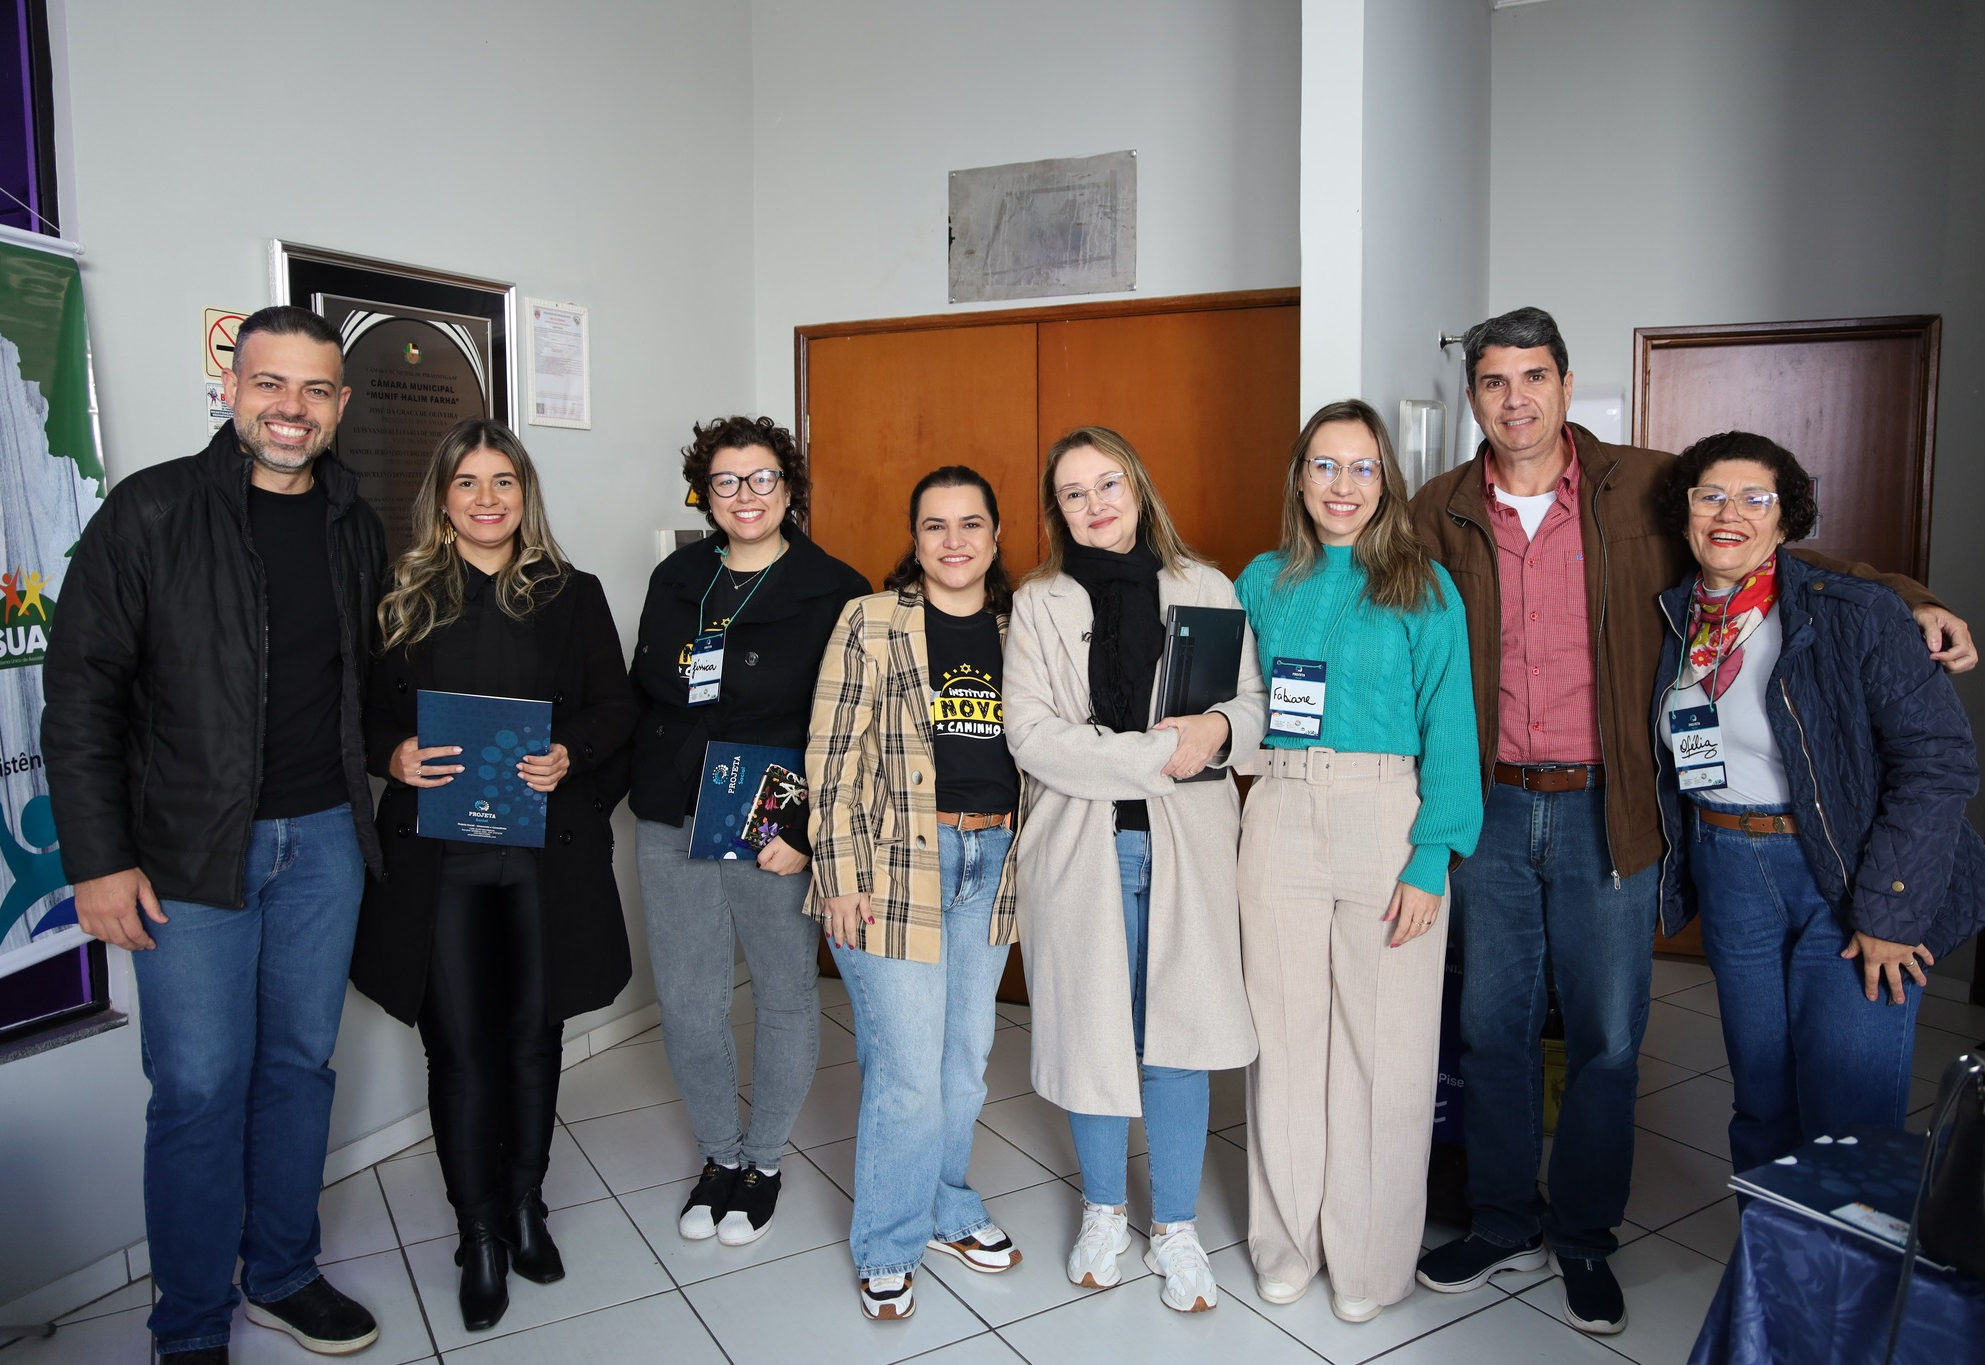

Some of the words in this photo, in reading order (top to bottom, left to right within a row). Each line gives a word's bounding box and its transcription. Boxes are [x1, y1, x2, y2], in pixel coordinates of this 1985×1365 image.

[370, 378, 408, 390] CÂMARA
[409, 382, 455, 394] MUNICIPAL
[401, 393, 428, 403] HALIM
[428, 411, 458, 419] OLIVEIRA
[1273, 686, 1316, 705] Fabiane
[947, 721, 1002, 735] CAMINHO
[727, 755, 741, 794] PROJETA
[738, 766, 746, 785] Social
[468, 811, 496, 819] PROJETA
